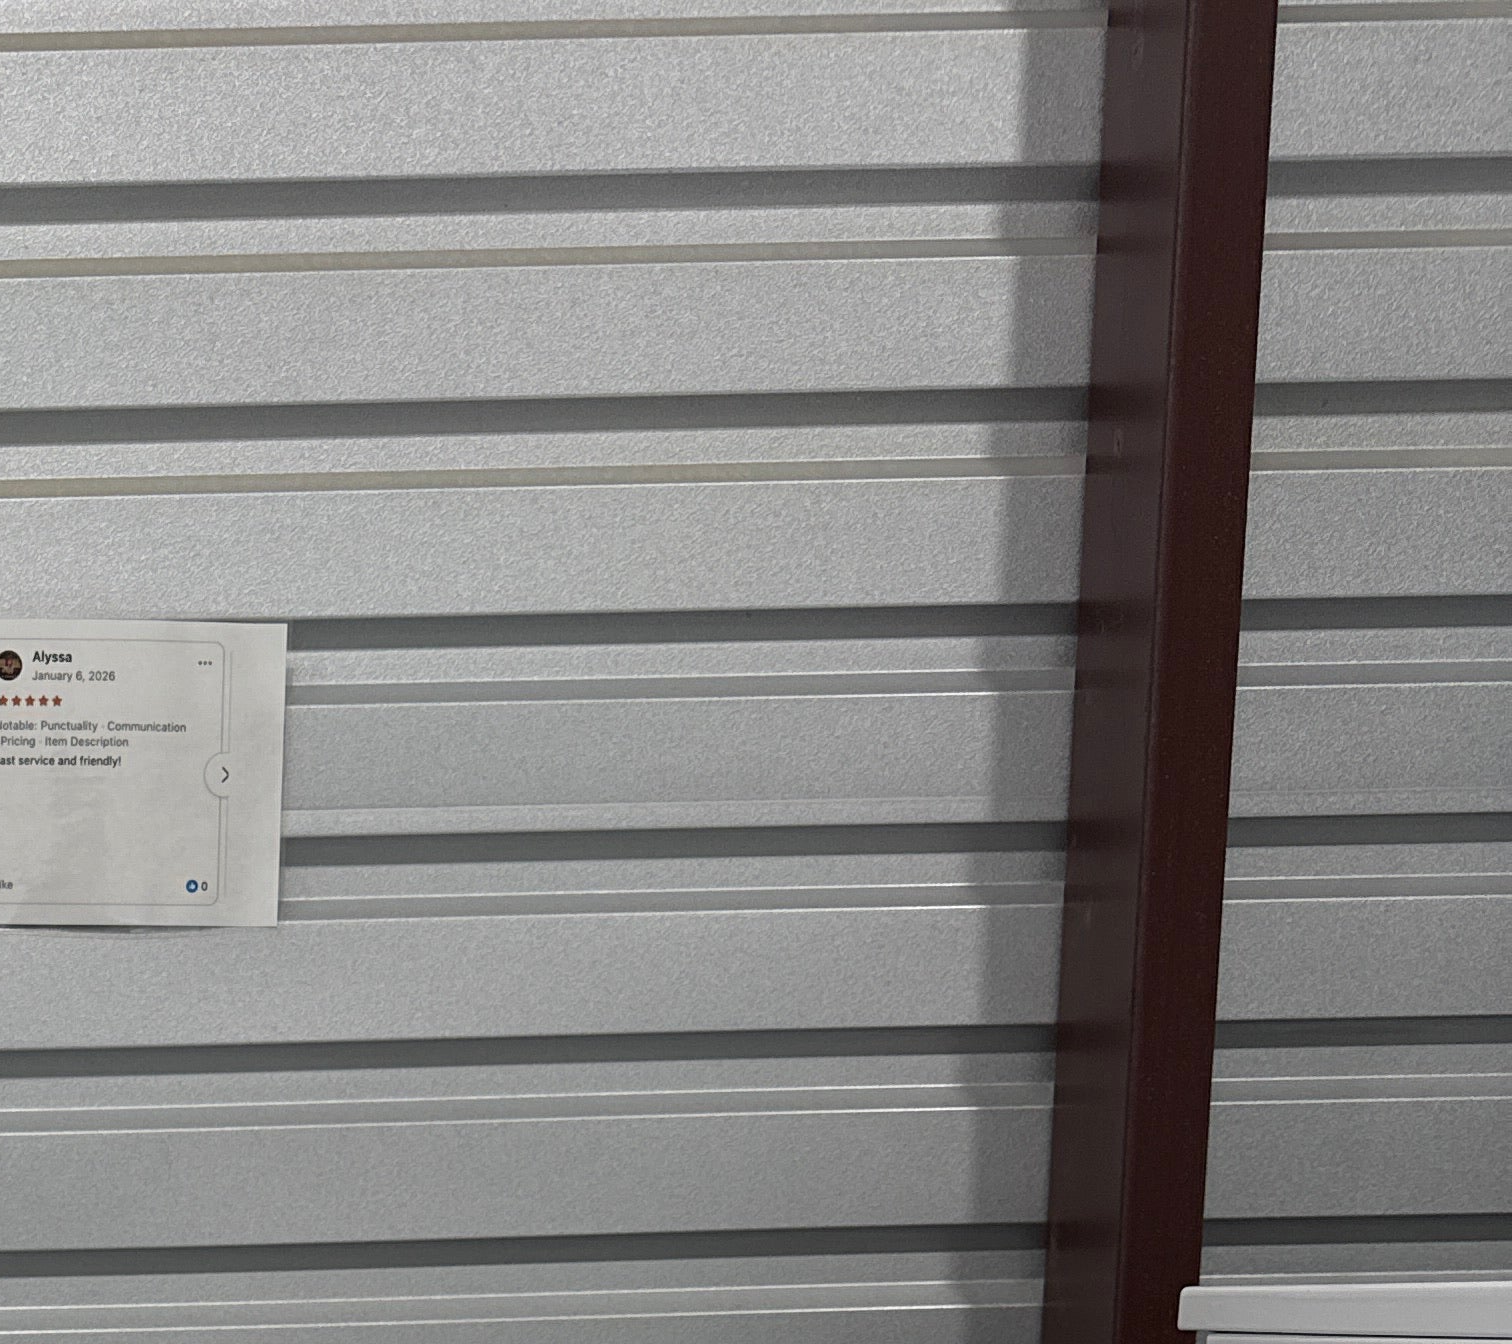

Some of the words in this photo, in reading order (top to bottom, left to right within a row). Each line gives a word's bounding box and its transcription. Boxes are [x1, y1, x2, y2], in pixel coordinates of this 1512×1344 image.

[32, 650, 73, 665] Alyssa
[32, 671, 73, 683] January
[76, 671, 86, 683] 6,
[88, 671, 116, 682] 2026
[40, 720, 98, 734] Punctuality
[107, 721, 187, 733] Communication
[0, 736, 36, 749] Pricing
[44, 736, 68, 747] Item
[70, 736, 129, 749] Description
[18, 756, 55, 766] service
[57, 756, 77, 766] and
[79, 755, 122, 769] friendly!
